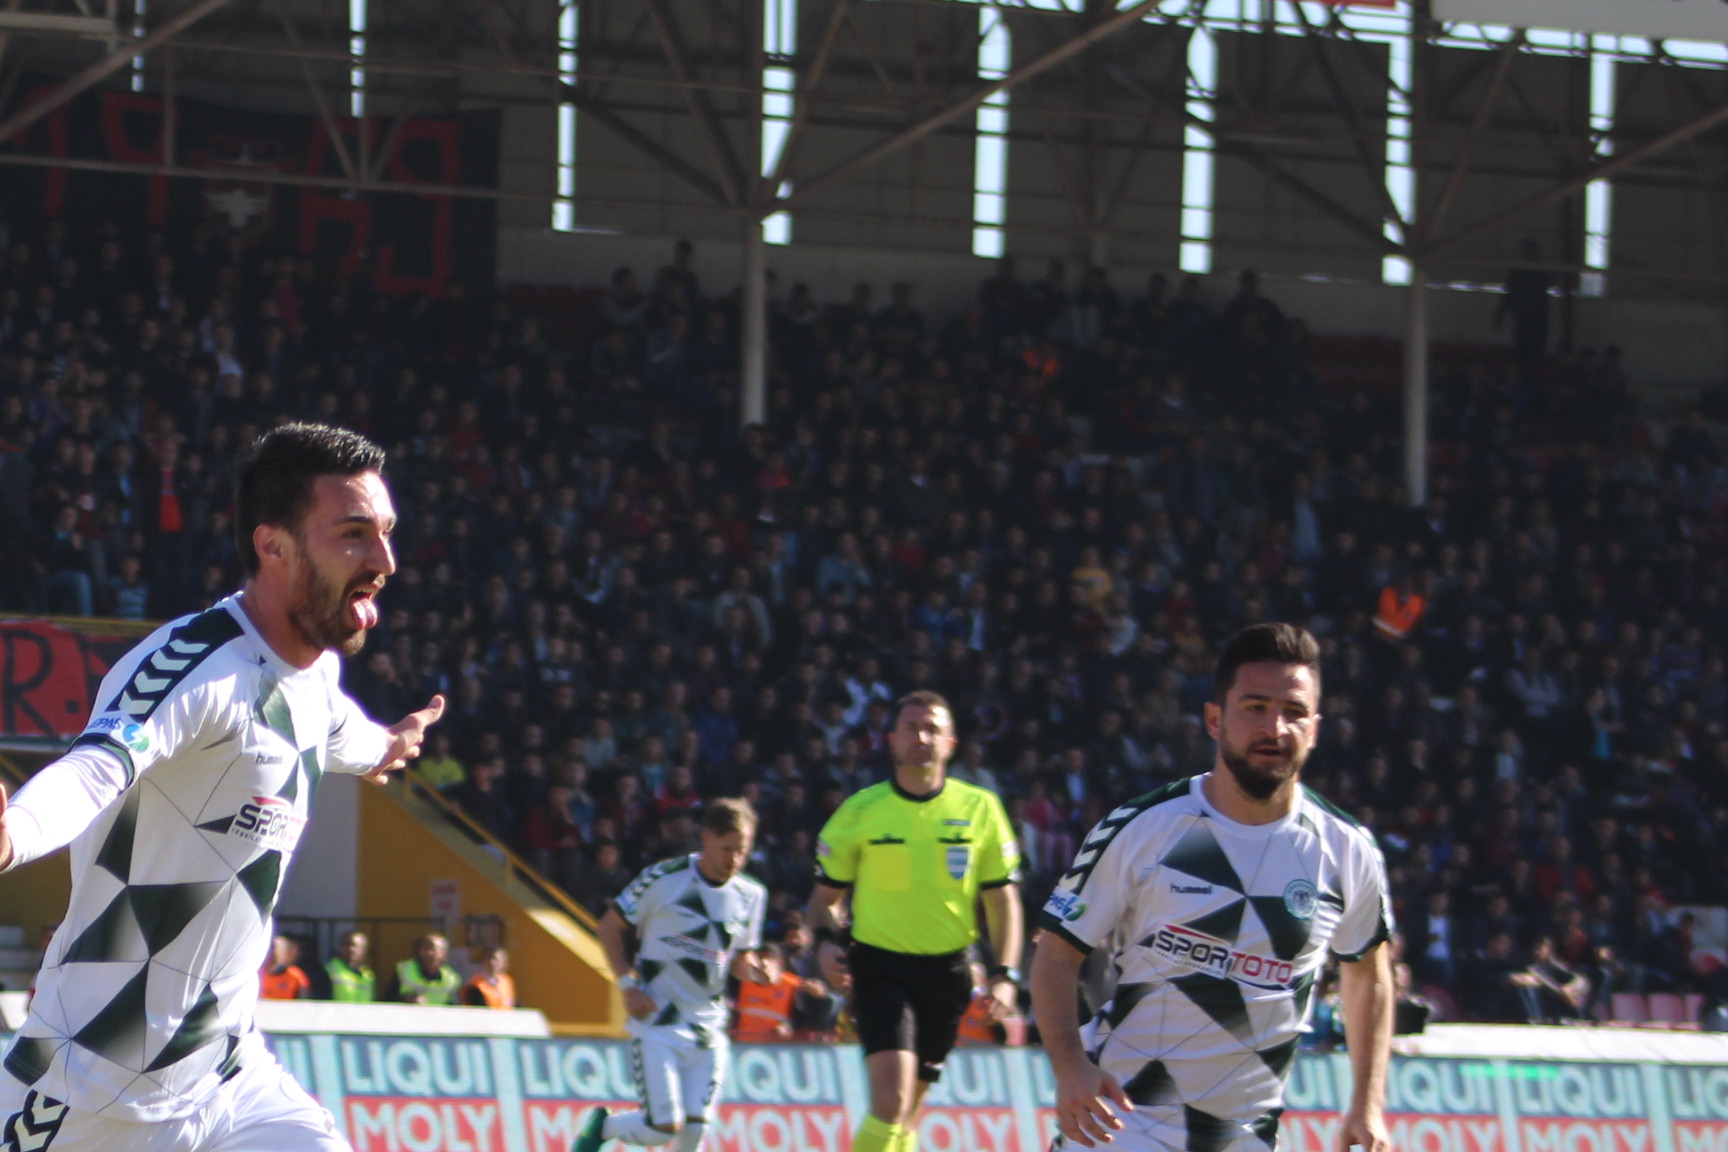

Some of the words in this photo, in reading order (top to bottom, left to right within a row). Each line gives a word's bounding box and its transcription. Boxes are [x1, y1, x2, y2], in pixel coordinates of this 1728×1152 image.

[341, 1039, 494, 1097] LIQUI
[519, 1043, 639, 1100] LIQU
[1386, 1059, 1497, 1116] IQUI
[1515, 1066, 1643, 1117] LIQUI
